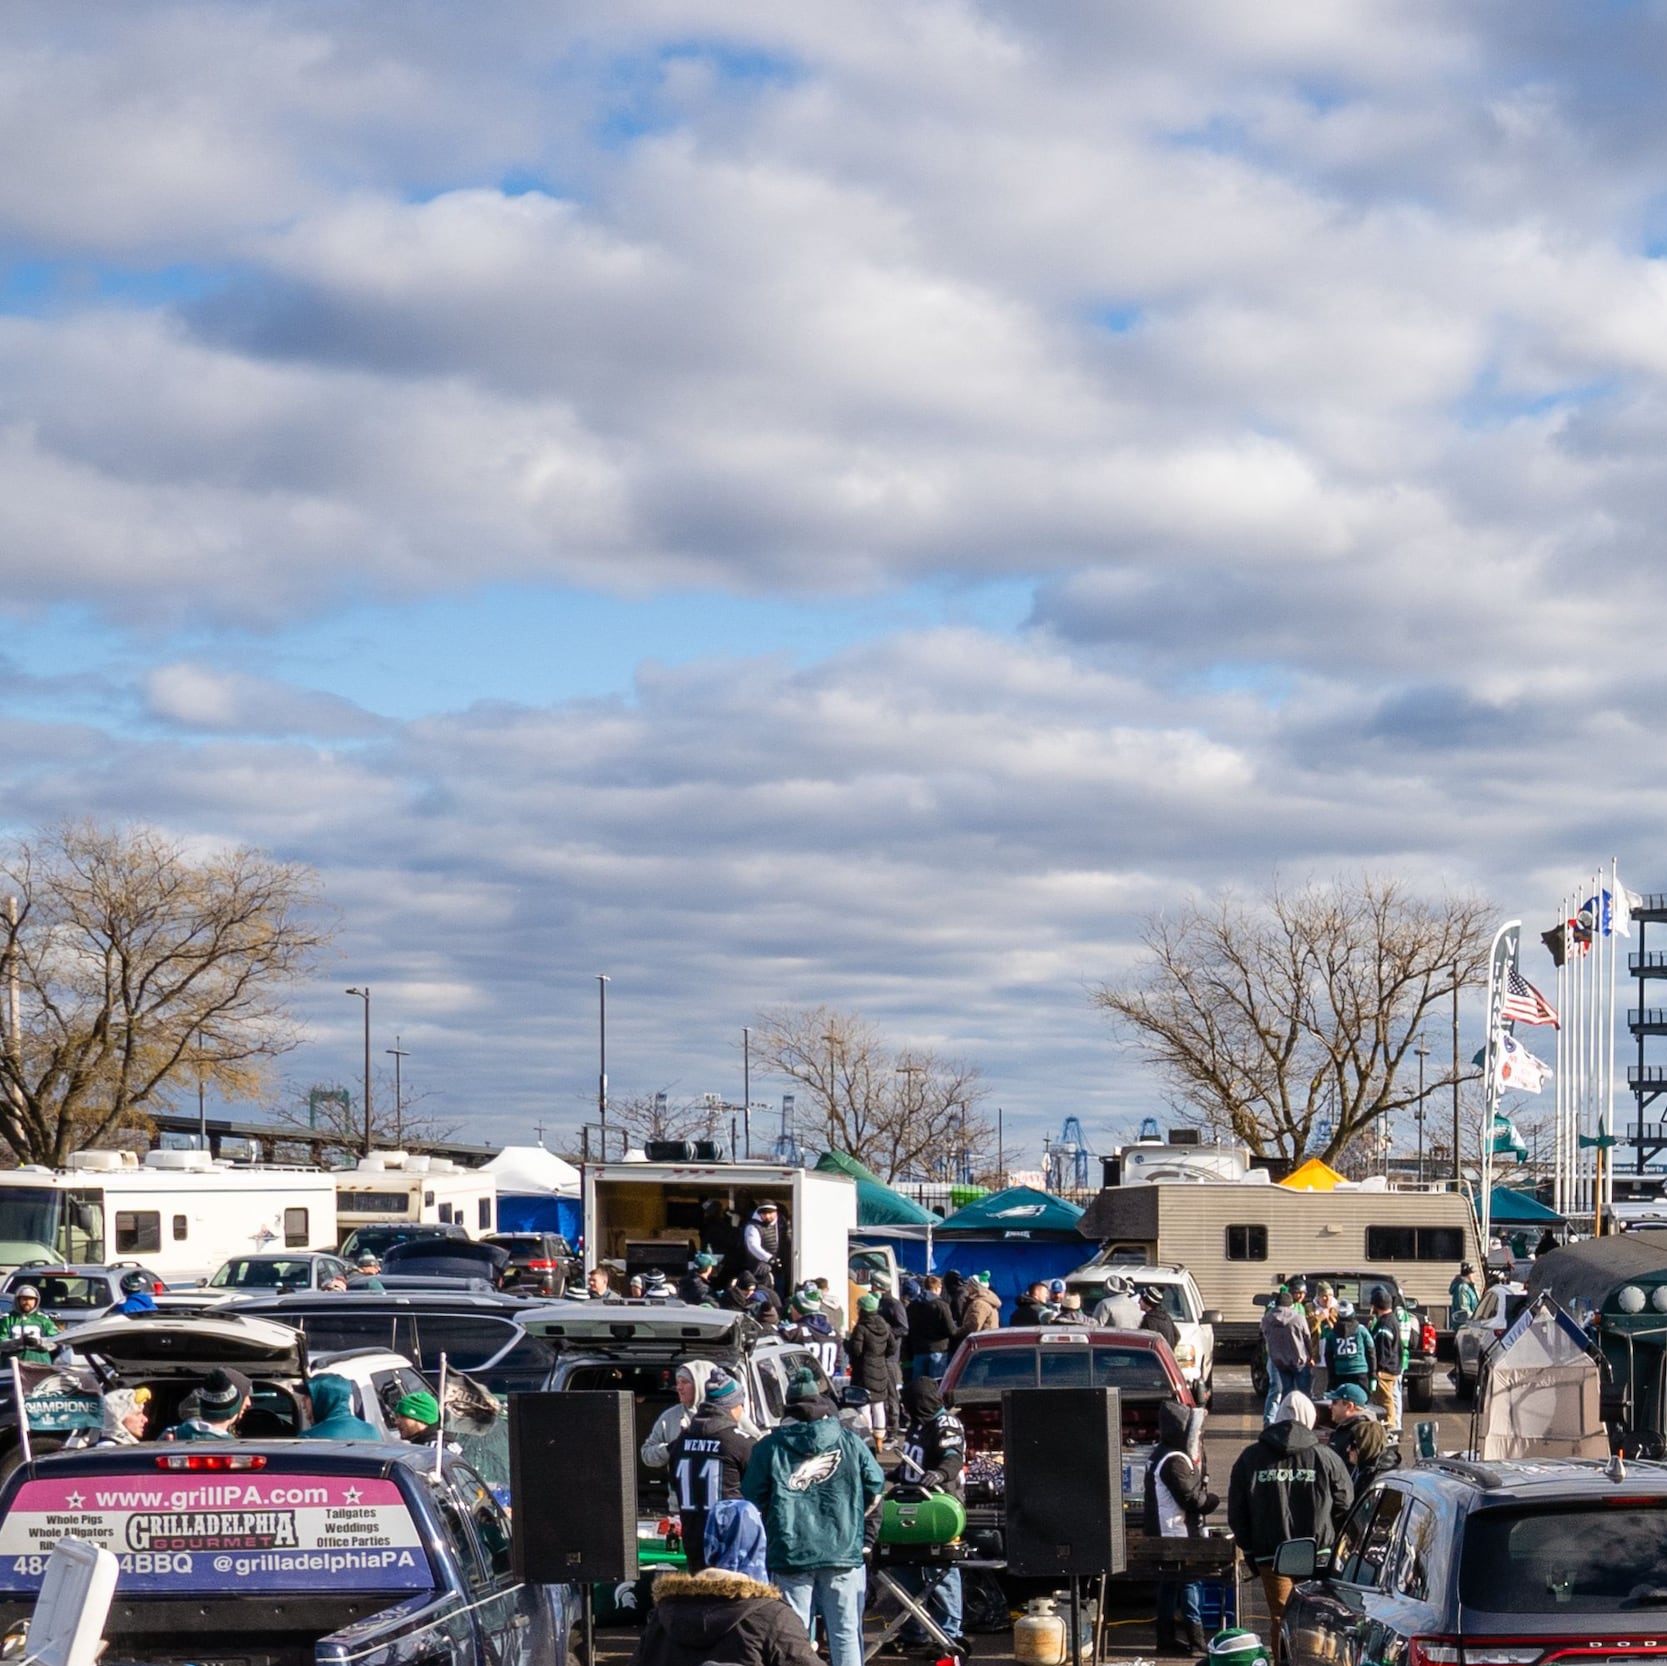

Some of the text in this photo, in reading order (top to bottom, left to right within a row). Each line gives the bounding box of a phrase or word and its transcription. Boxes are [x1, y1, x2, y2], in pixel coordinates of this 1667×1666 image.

[1336, 1335, 1357, 1356] 25
[683, 1439, 720, 1453] WENTZ
[676, 1458, 720, 1510] 11
[95, 1484, 329, 1509] www.grillPA.com
[46, 1513, 104, 1527] Whole Pigs
[325, 1508, 377, 1521] Tailgates
[28, 1525, 115, 1540] Whole Alligators
[126, 1510, 298, 1551] GRILLADELPHIA
[324, 1522, 380, 1536] Weddings
[153, 1536, 272, 1550] GOURMET
[316, 1535, 391, 1549] Office Parties
[119, 1553, 193, 1575] 4BBQ
[212, 1551, 416, 1576] @grilladelphiaPA
